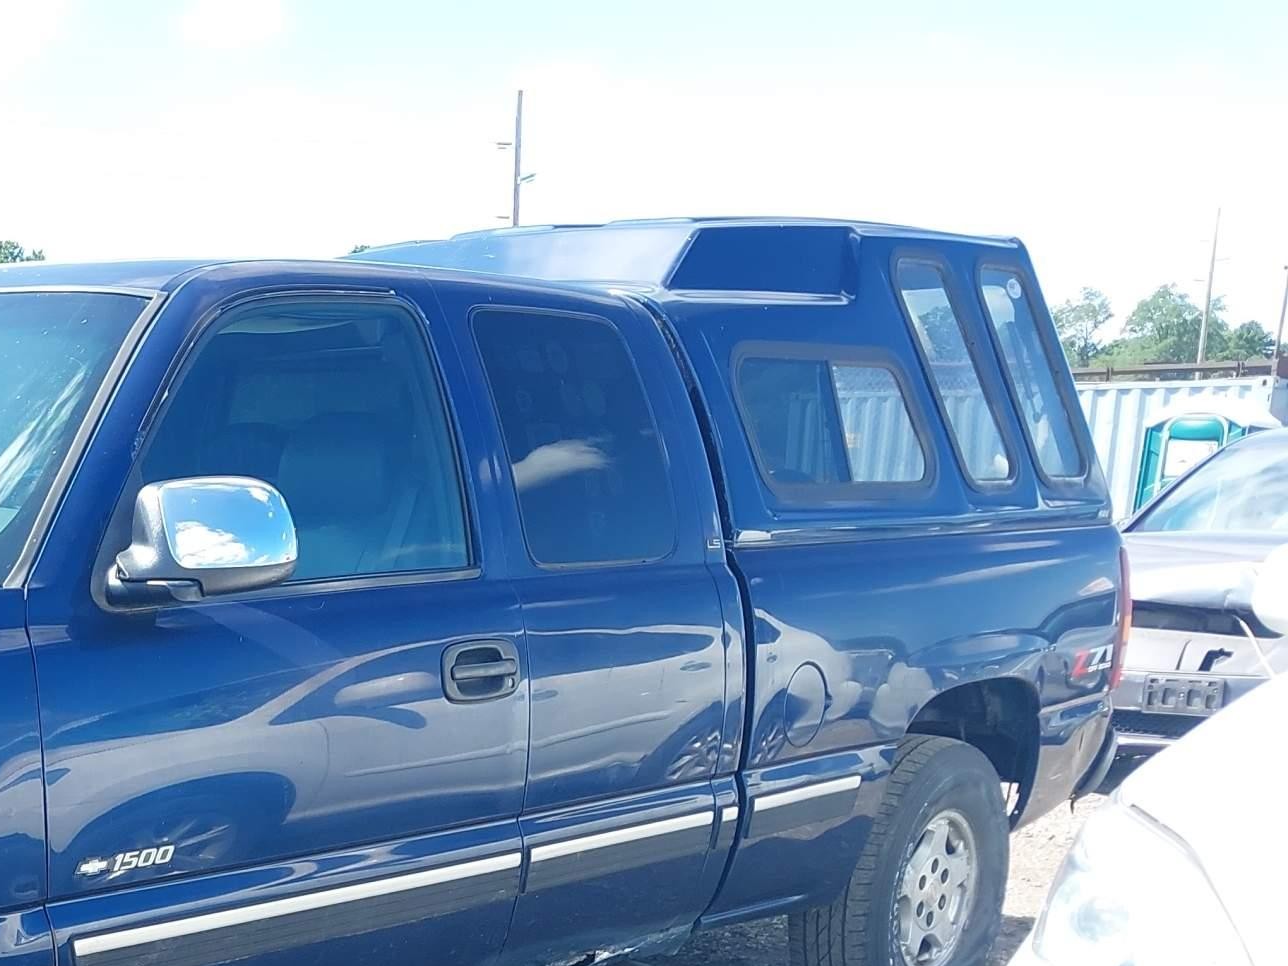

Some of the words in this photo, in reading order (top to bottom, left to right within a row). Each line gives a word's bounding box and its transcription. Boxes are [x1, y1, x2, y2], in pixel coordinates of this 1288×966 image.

[706, 538, 721, 549] LS
[1072, 643, 1114, 679] Z71
[113, 844, 176, 872] 1500
